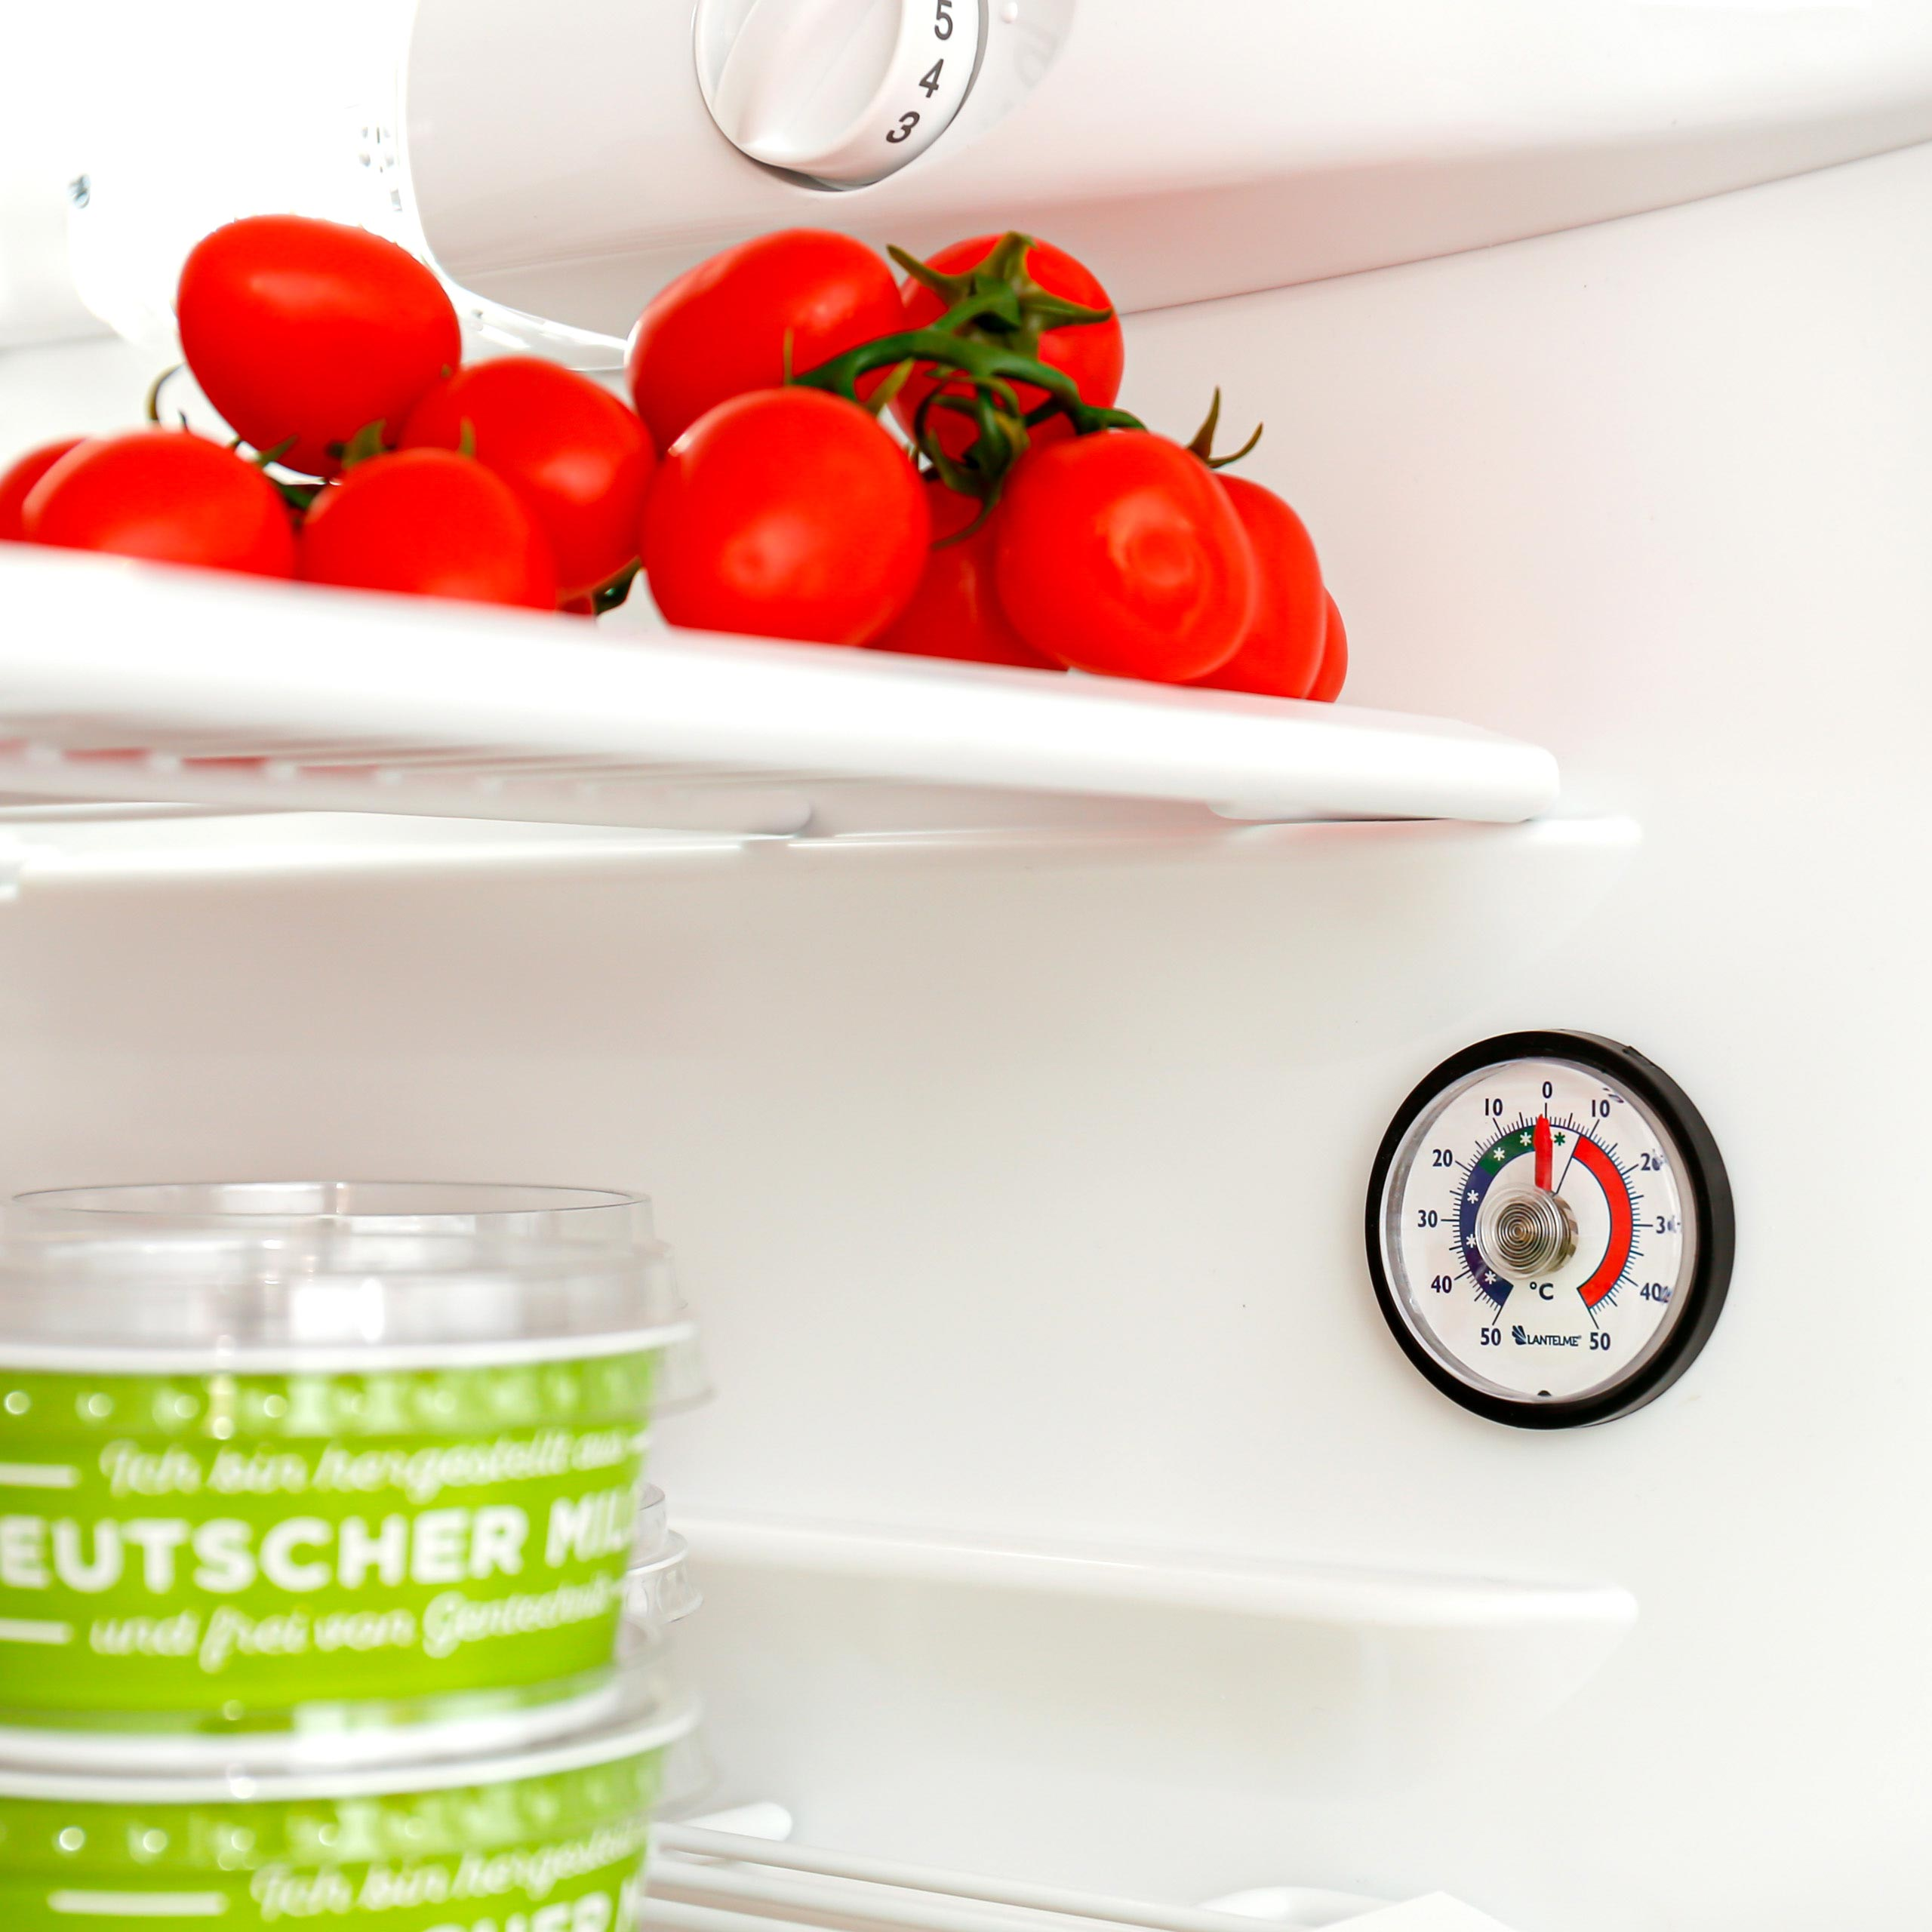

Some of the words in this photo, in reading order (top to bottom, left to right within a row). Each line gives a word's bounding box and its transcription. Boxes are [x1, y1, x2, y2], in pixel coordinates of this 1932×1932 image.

[934, 0, 954, 41] 5
[918, 58, 945, 98] 4
[885, 111, 921, 143] 3
[1542, 1081, 1553, 1099] 0
[1484, 1098, 1503, 1116] 10
[1591, 1099, 1611, 1118] 10
[1432, 1149, 1453, 1168] 20
[1417, 1210, 1438, 1228] 30
[1431, 1275, 1452, 1294] 40
[1480, 1328, 1501, 1346] 50
[1589, 1332, 1611, 1351] 50
[0, 1513, 528, 1594] EUTSCHER
[545, 1488, 640, 1568] MIL
